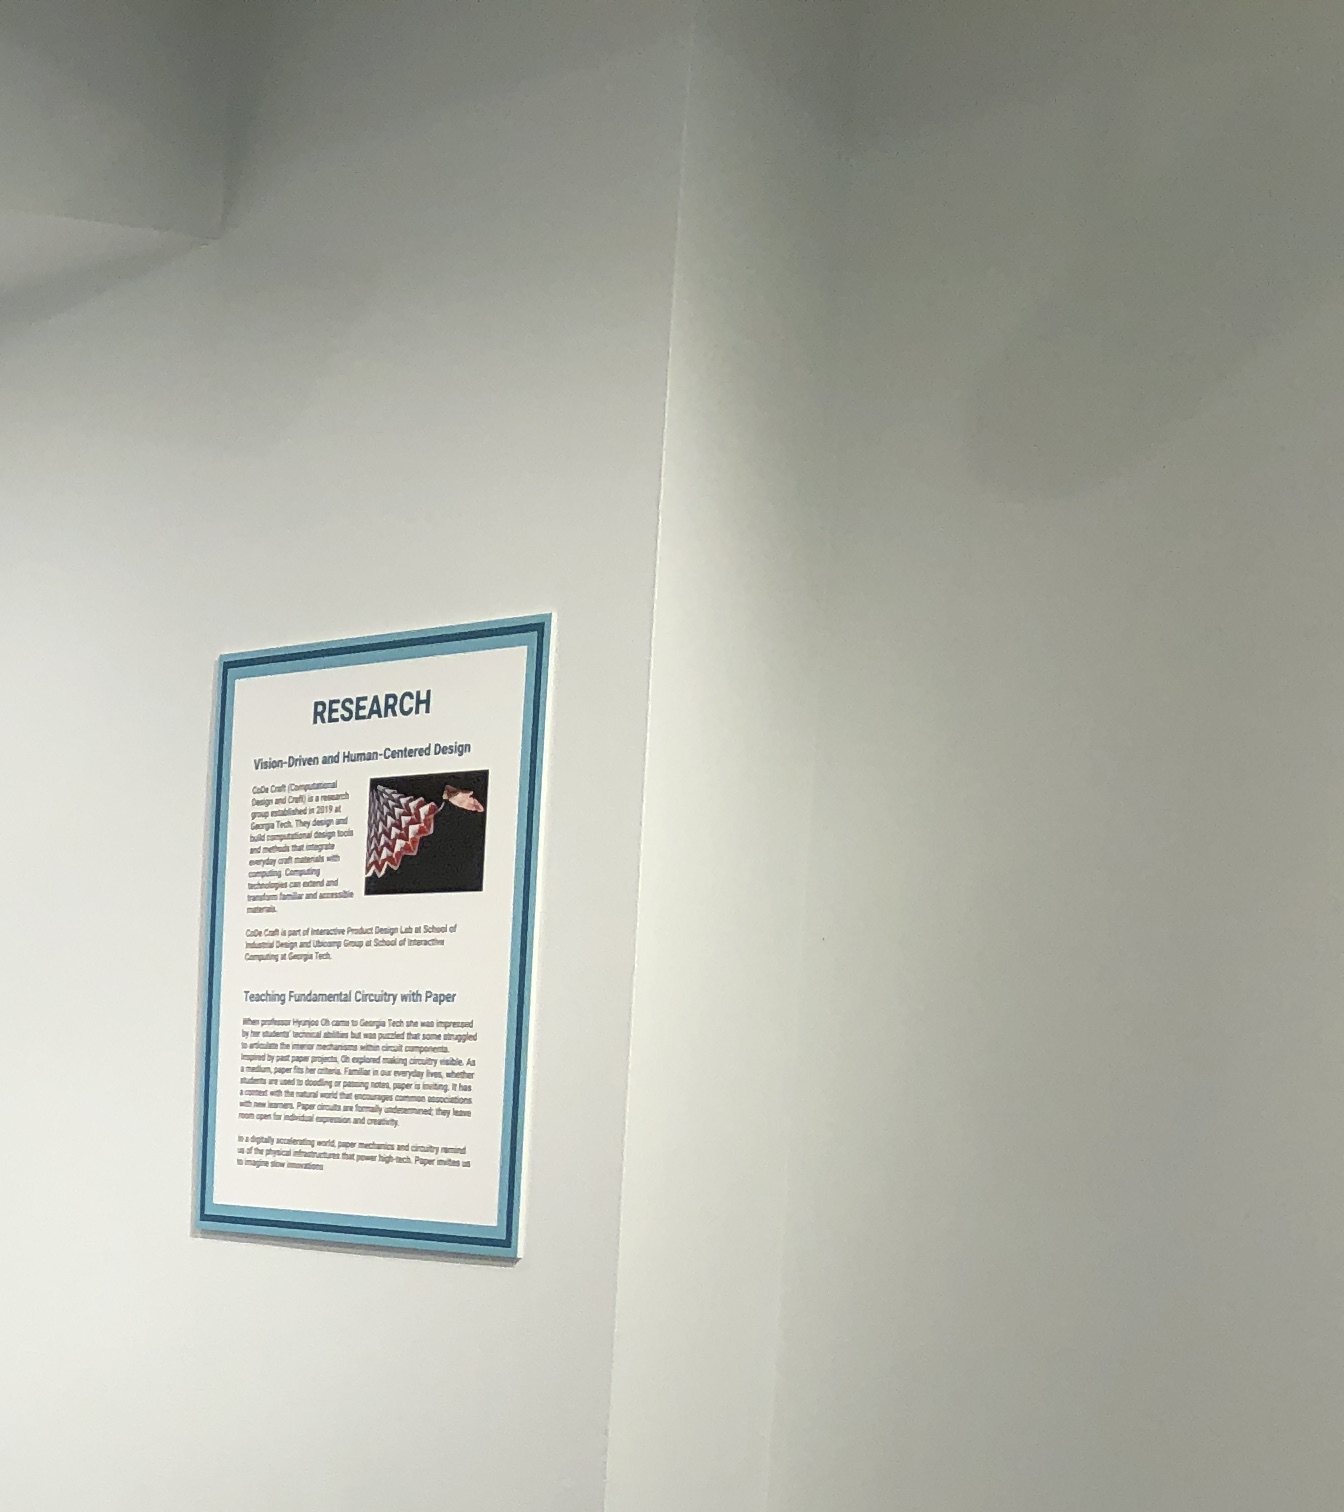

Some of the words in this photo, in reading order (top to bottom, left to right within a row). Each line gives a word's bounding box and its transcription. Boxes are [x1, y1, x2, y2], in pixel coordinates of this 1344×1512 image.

[312, 689, 430, 725] RESEARCH
[254, 753, 319, 770] Vision-Driven
[321, 751, 339, 765] and
[342, 744, 430, 763] Human-Centered
[433, 741, 470, 759] Design
[287, 951, 313, 962] Georgia
[315, 950, 331, 959] Tech.
[244, 990, 286, 1005] Teaching
[288, 990, 351, 1002] Fundamental
[354, 990, 397, 1005] Circuitry
[400, 990, 422, 1002] with
[424, 990, 455, 1006] Paper
